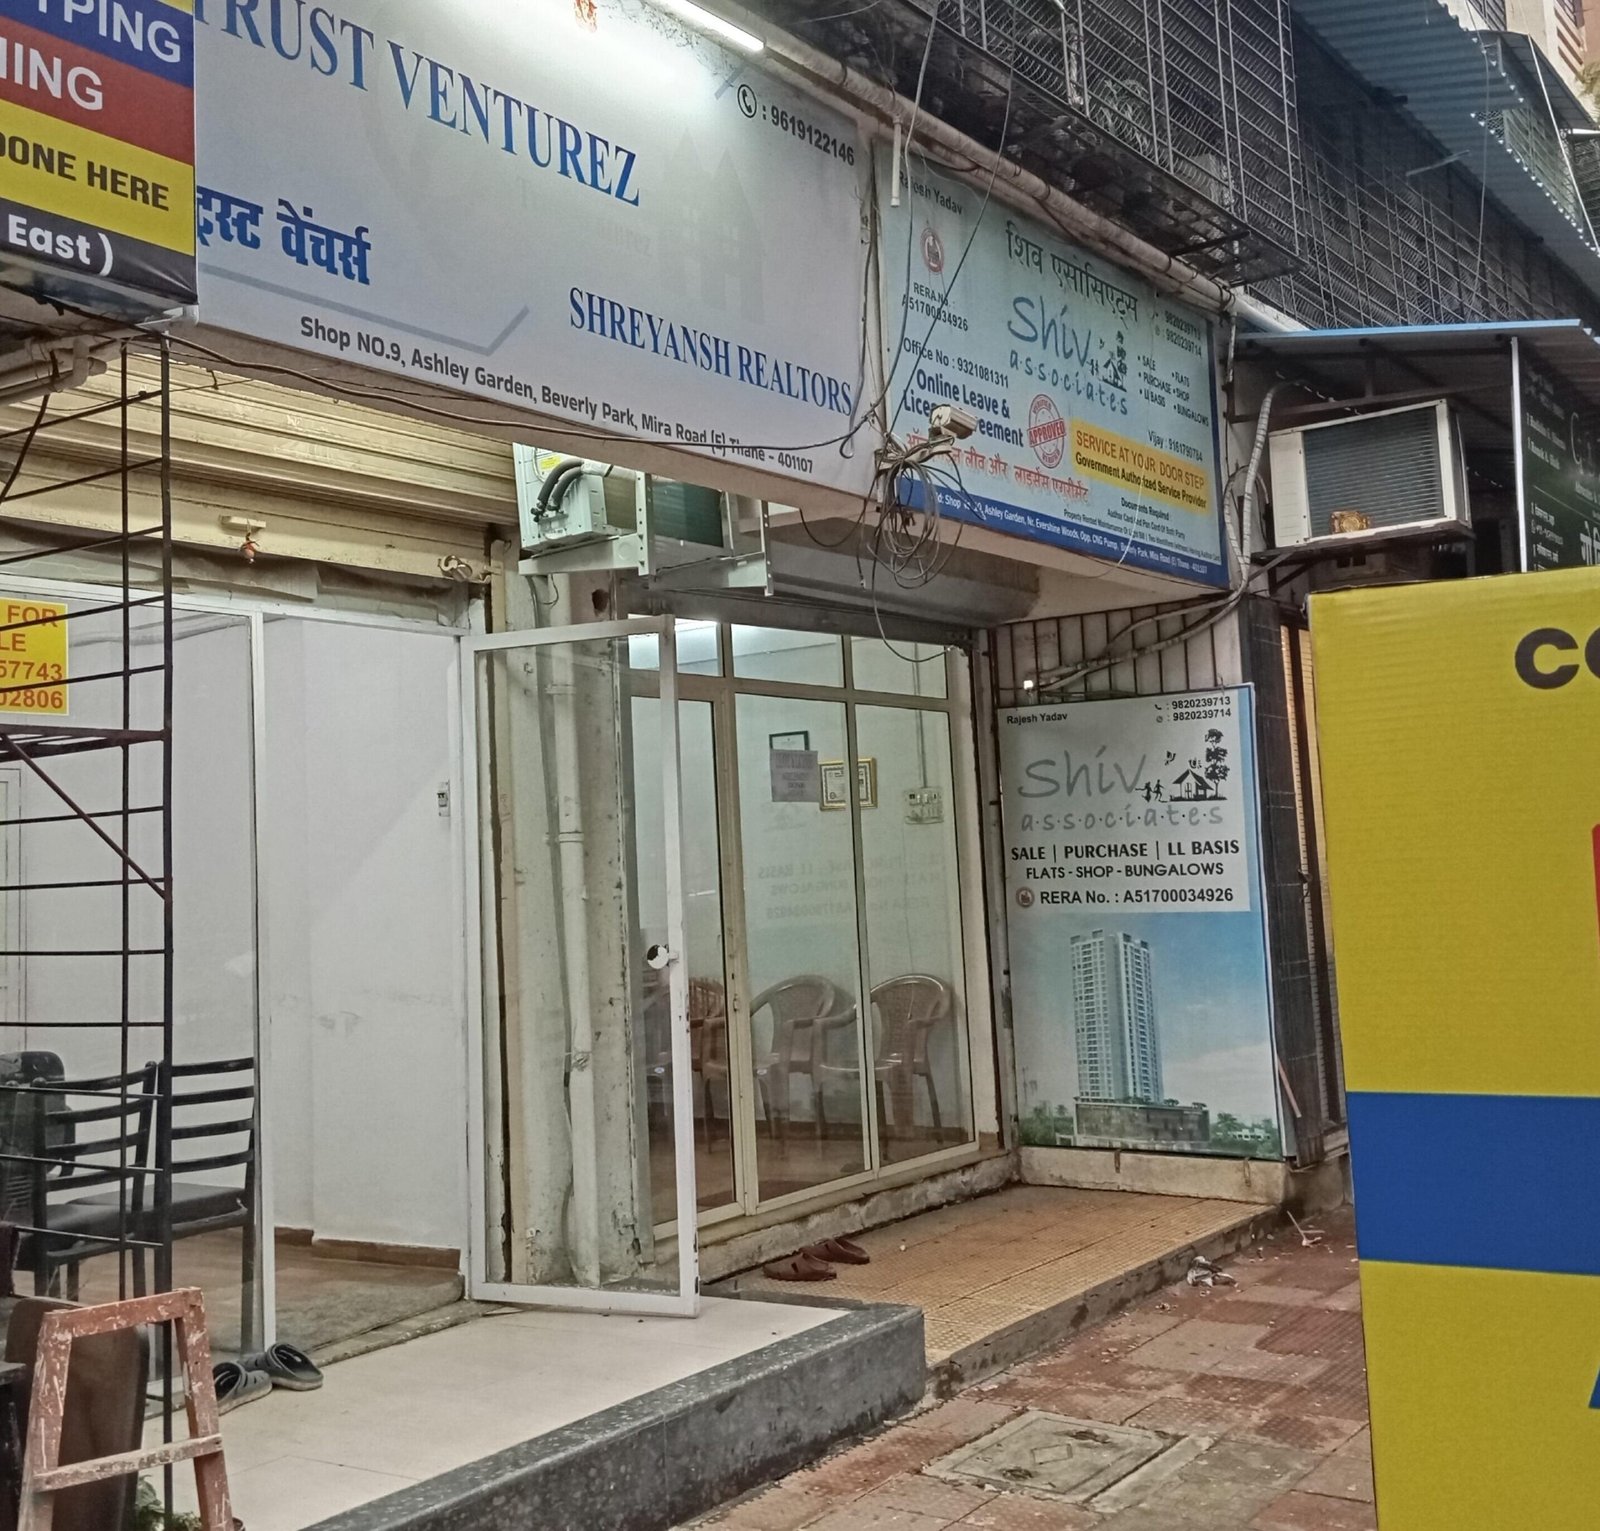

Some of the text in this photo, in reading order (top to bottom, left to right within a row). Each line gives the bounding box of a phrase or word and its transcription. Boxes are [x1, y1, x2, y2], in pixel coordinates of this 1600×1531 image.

[0, 36, 103, 111] ING
[386, 39, 640, 207] VENTUREZ
[771, 105, 855, 166] 9619122146
[0, 131, 169, 211] ONE HERE
[934, 190, 962, 215] Yadav
[276, 198, 371, 286] वेंचर्स
[1006, 220, 1044, 274] शिव
[569, 287, 852, 416] SHREYANSH REALTORS
[1007, 295, 1091, 367] Shiv
[300, 316, 350, 351] Shop
[411, 348, 470, 385] Ashley
[475, 367, 537, 404] Garden,
[541, 386, 597, 420] Beverly
[602, 403, 638, 431] Park,
[641, 414, 672, 437] Mira
[675, 423, 707, 444] Road
[777, 452, 813, 474] 401107
[916, 368, 960, 402] Online
[962, 384, 999, 415] Leave
[1001, 398, 1011, 419] &
[957, 357, 1009, 388] 9321081311
[1075, 452, 1120, 478] Government
[1158, 481, 1181, 500] Service
[1182, 489, 1207, 508] Provider
[1076, 430, 1117, 459] SERVICE
[1119, 444, 1129, 463] AT
[1159, 461, 1183, 483] DOOR
[1185, 470, 1205, 490] STEP
[985, 505, 1003, 520] Ashley
[7, 605, 58, 627] FOR
[1515, 626, 1600, 690] C
[1006, 712, 1068, 725] Rajesh Yadav
[1172, 696, 1231, 710] 9820239713
[1173, 708, 1231, 722] 9820239714
[1017, 745, 1146, 798] Shiv
[1011, 847, 1045, 861] SALE
[1064, 843, 1148, 859] PURCHASE
[1168, 842, 1186, 856] LL
[1191, 840, 1240, 855] BASIS
[1026, 866, 1066, 879] FLATS
[1076, 865, 1114, 878] SHOP
[1125, 863, 1224, 877] BUNGALOWS
[1041, 891, 1082, 905] RERA
[1086, 891, 1110, 904] No.
[1123, 888, 1234, 903] A51700034926
